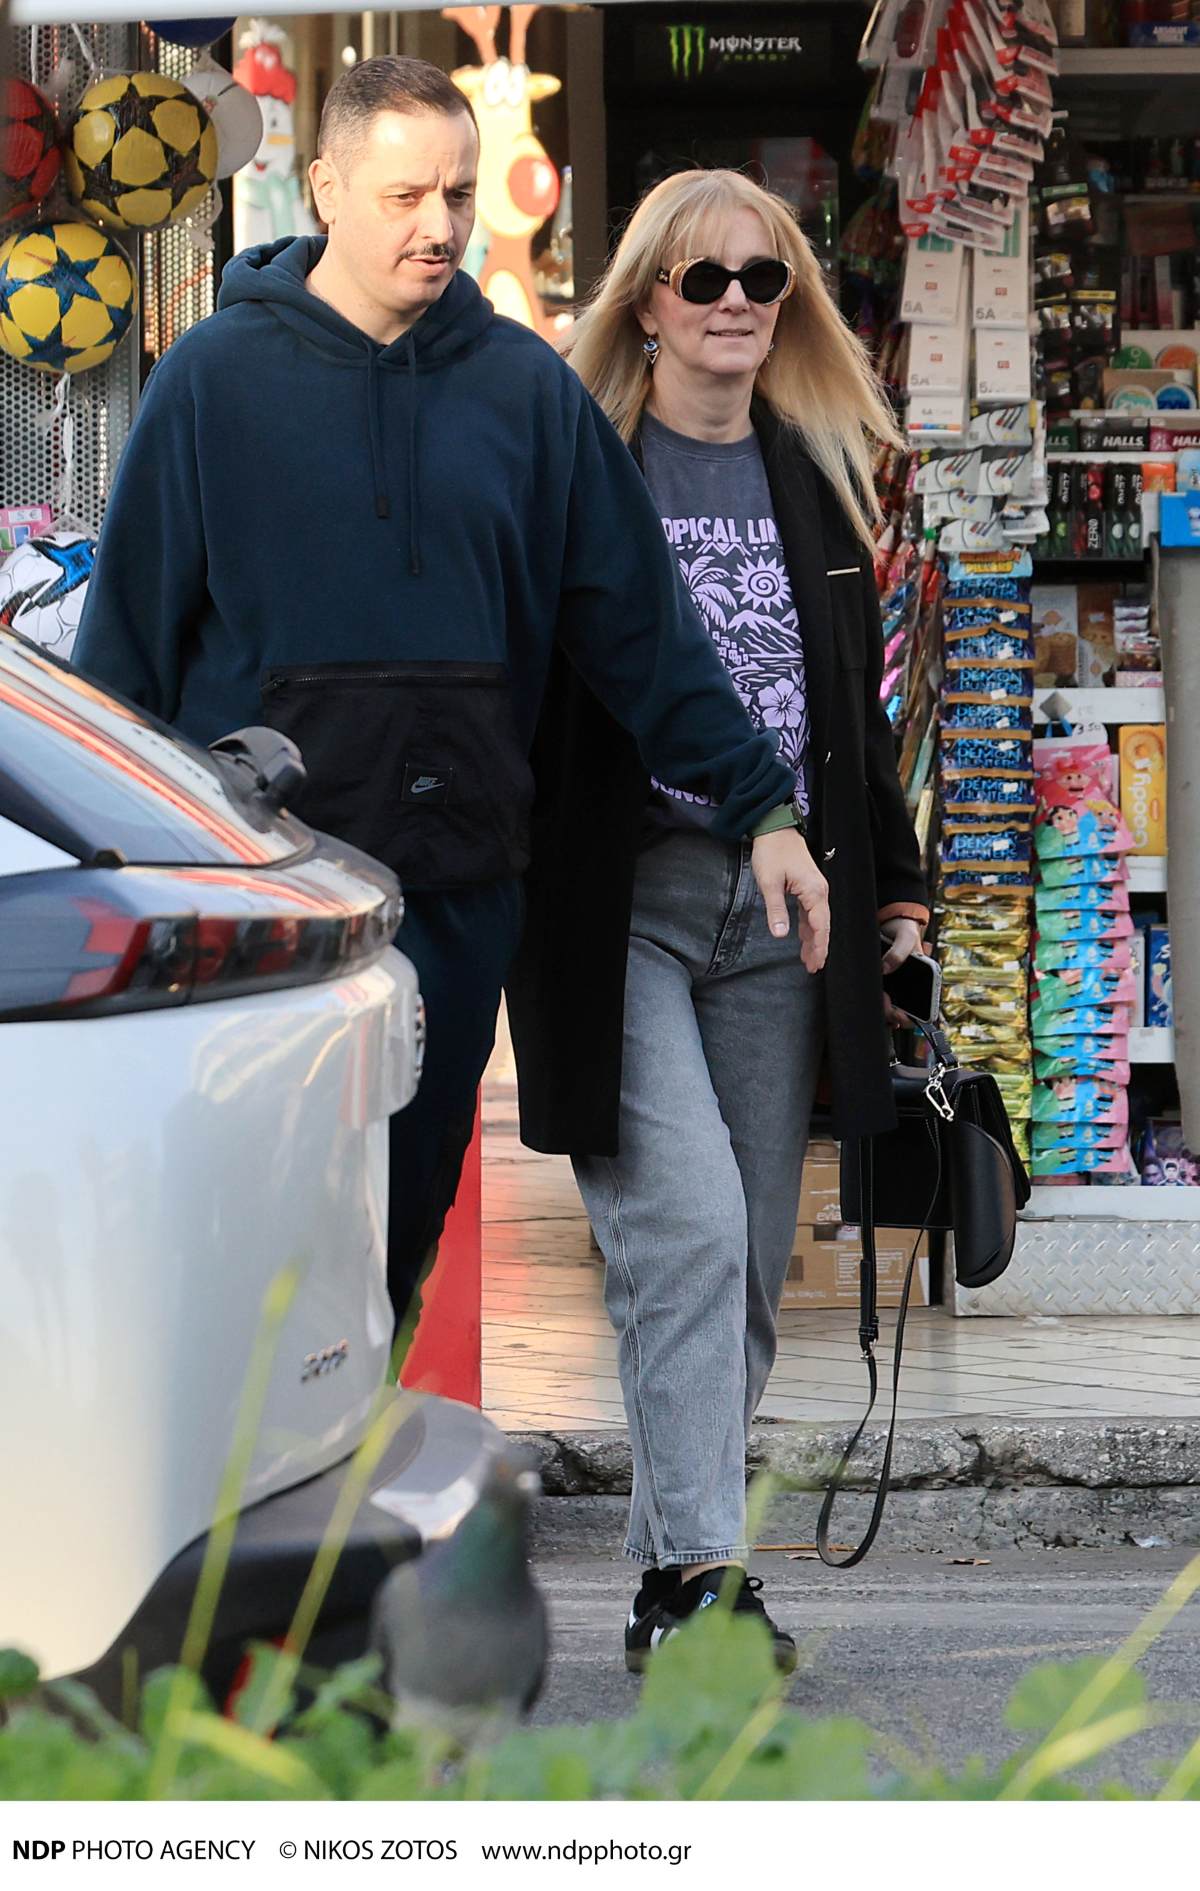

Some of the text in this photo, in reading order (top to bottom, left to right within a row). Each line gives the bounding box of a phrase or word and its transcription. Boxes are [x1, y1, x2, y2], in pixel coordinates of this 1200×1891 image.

[709, 34, 802, 52] MONSTER
[975, 308, 996, 320] 5A
[1103, 436, 1144, 447] HALLS
[661, 517, 742, 544] OPICAL
[1088, 518, 1099, 549] ZERO
[958, 748, 1020, 760] DEMON
[961, 789, 1022, 802] HUNTERS
[816, 1211, 841, 1222] evia
